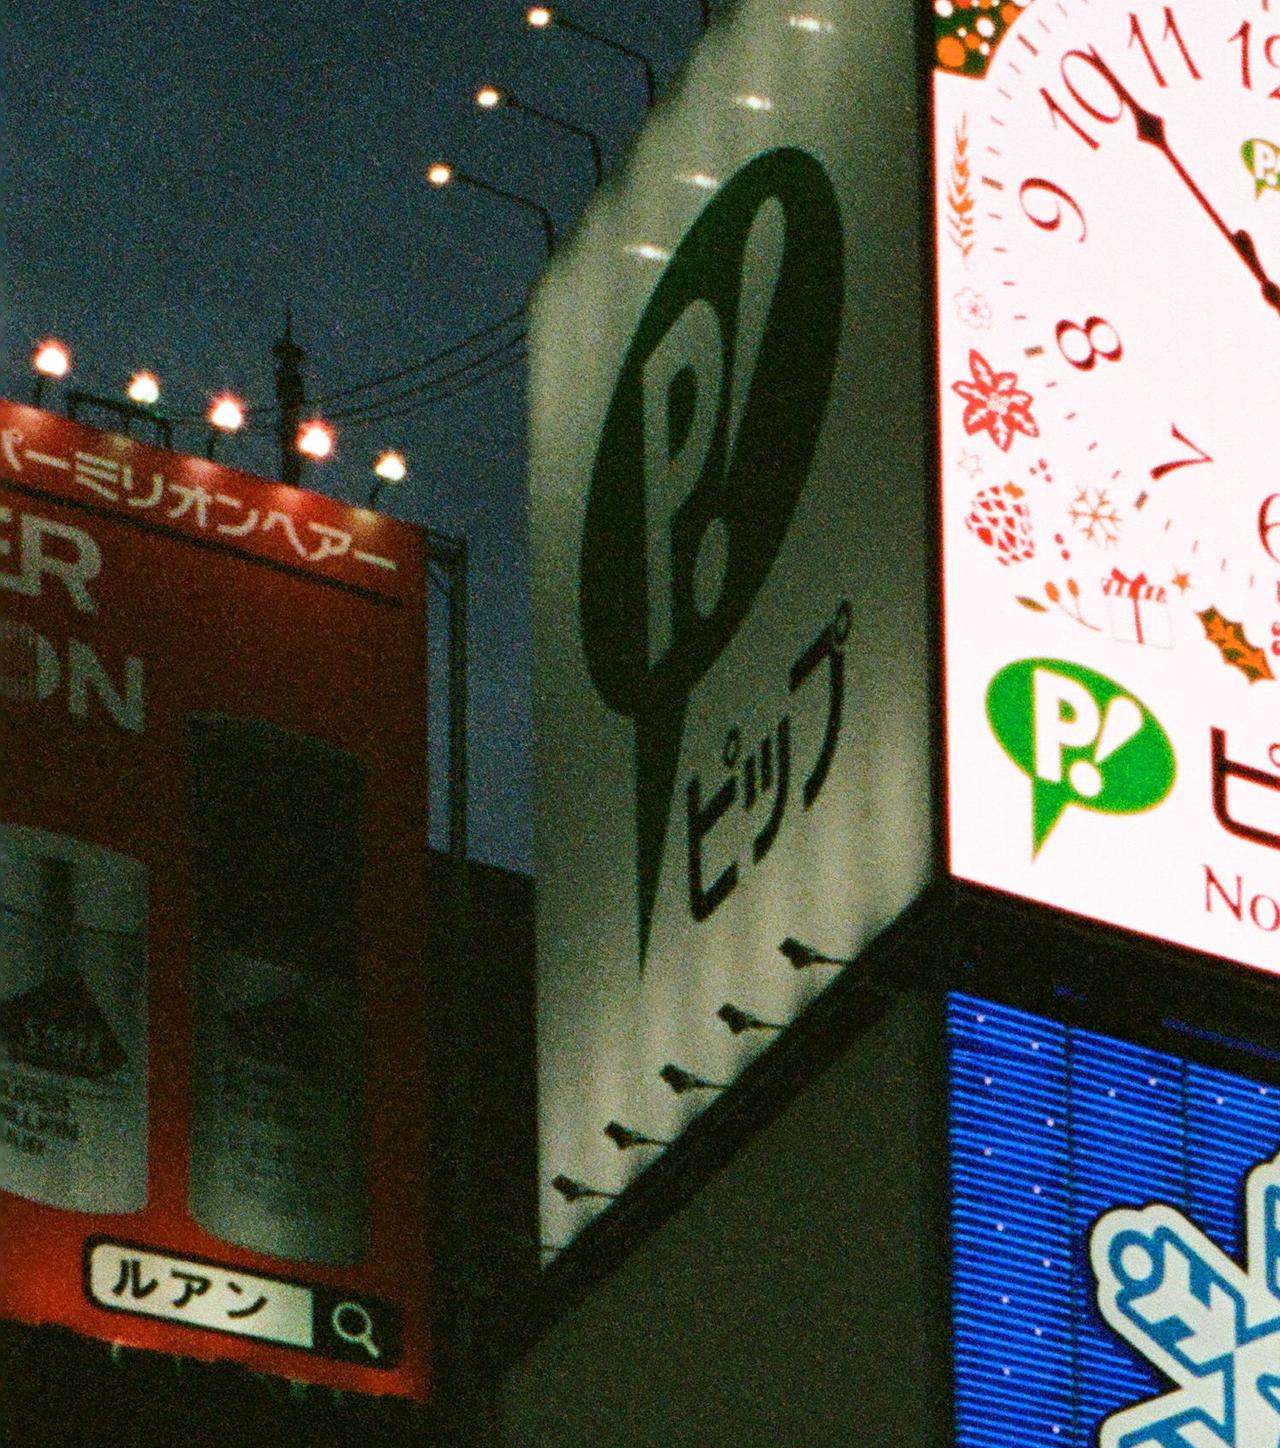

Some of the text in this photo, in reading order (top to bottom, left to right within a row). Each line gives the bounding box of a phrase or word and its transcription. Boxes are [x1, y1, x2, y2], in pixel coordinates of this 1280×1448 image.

[1039, 46, 1126, 151] 10
[1018, 176, 1087, 243] 9
[1055, 315, 1124, 371] 8
[1150, 423, 1214, 480] 7
[688, 601, 852, 922] ピップ
[113, 1258, 267, 1320] ルアン
